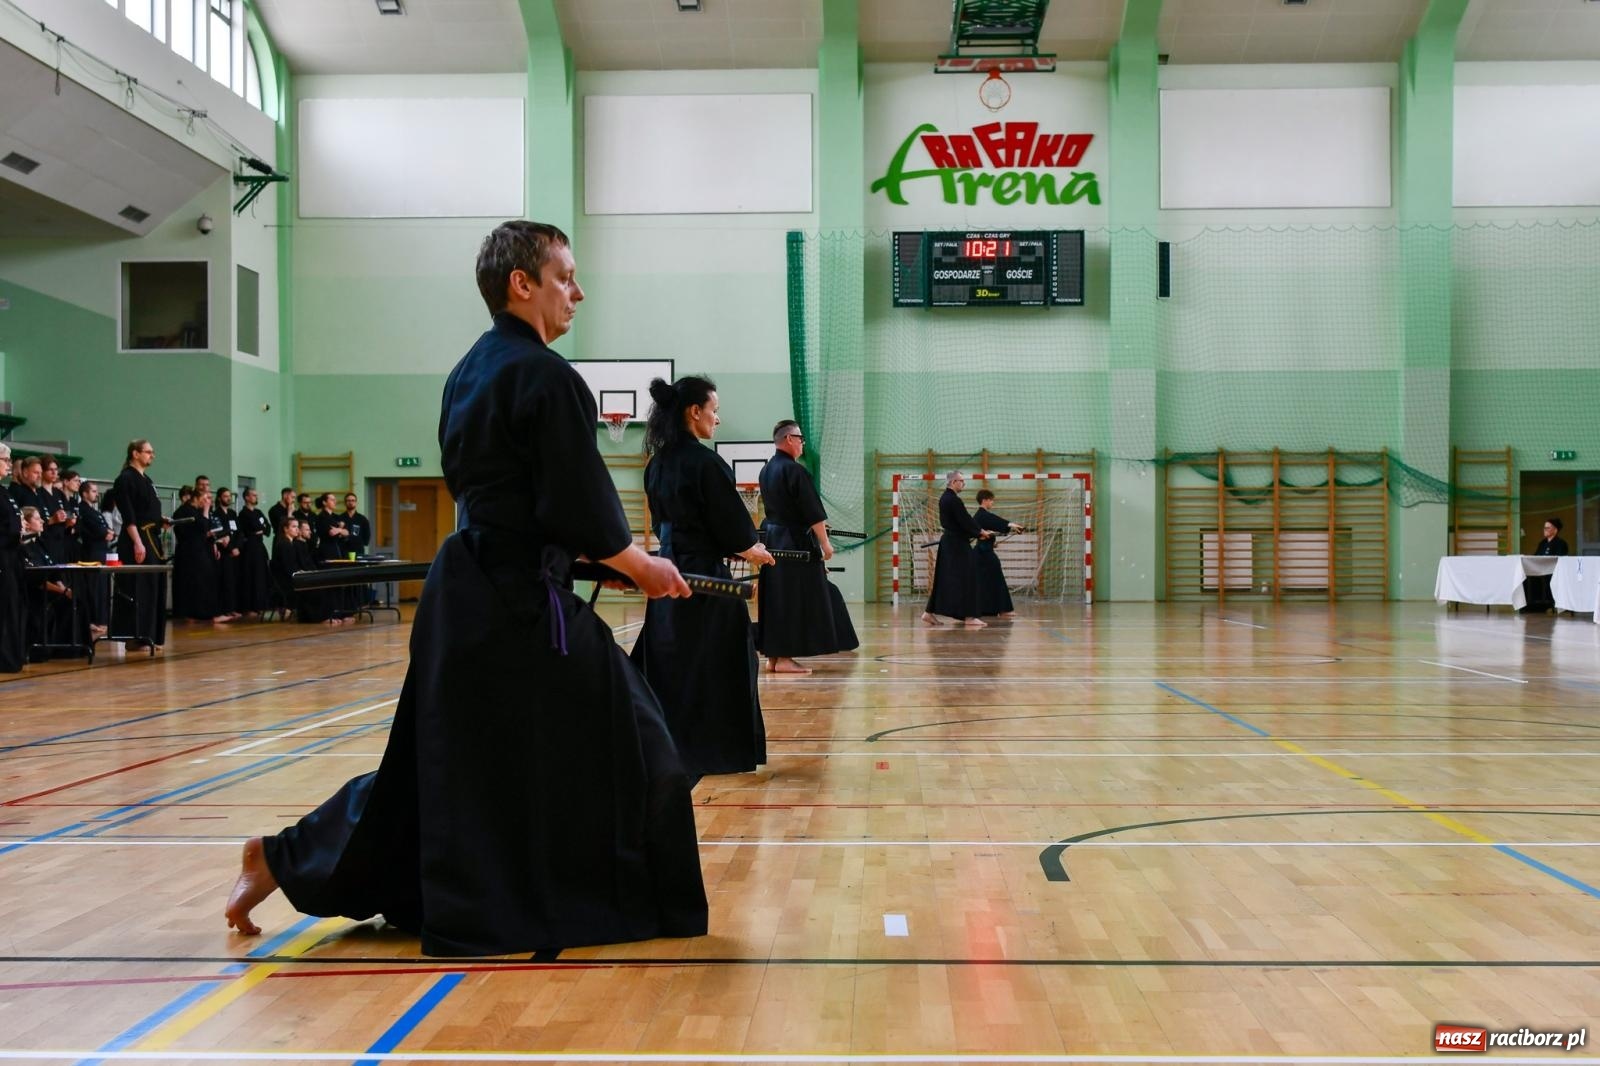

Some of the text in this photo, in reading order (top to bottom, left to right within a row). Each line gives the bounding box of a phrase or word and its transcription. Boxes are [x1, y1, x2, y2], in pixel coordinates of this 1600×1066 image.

[920, 122, 1094, 169] RAFAKO
[870, 123, 1102, 206] Arena
[965, 241, 1010, 257] 10:21
[933, 270, 981, 279] GOSPODARZE
[1006, 267, 1033, 279] GOŚCIE
